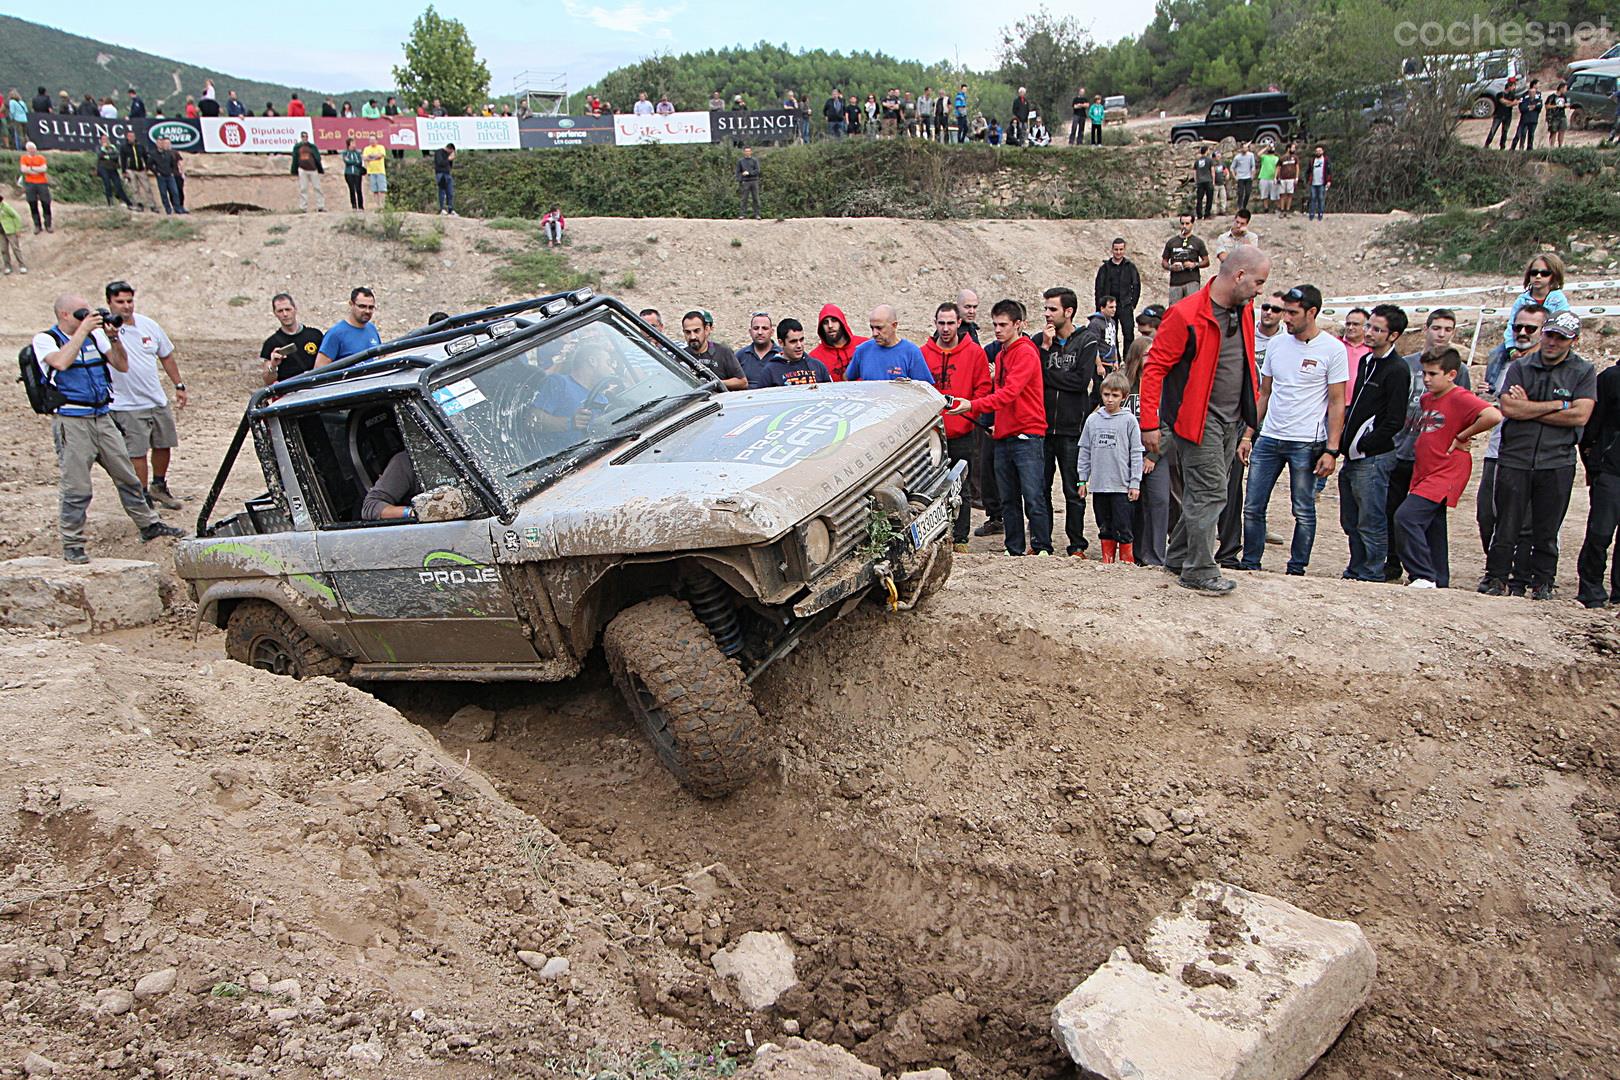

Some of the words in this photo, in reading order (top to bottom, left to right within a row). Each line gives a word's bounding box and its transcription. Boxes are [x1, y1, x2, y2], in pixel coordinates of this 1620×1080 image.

[426, 121, 460, 130] BAGES
[476, 120, 509, 129] BAGES
[718, 115, 795, 131] SILENCI
[159, 127, 183, 135] LAND
[252, 137, 299, 146] Barcelona
[823, 452, 875, 494] RANGE
[880, 416, 920, 451] ROVER
